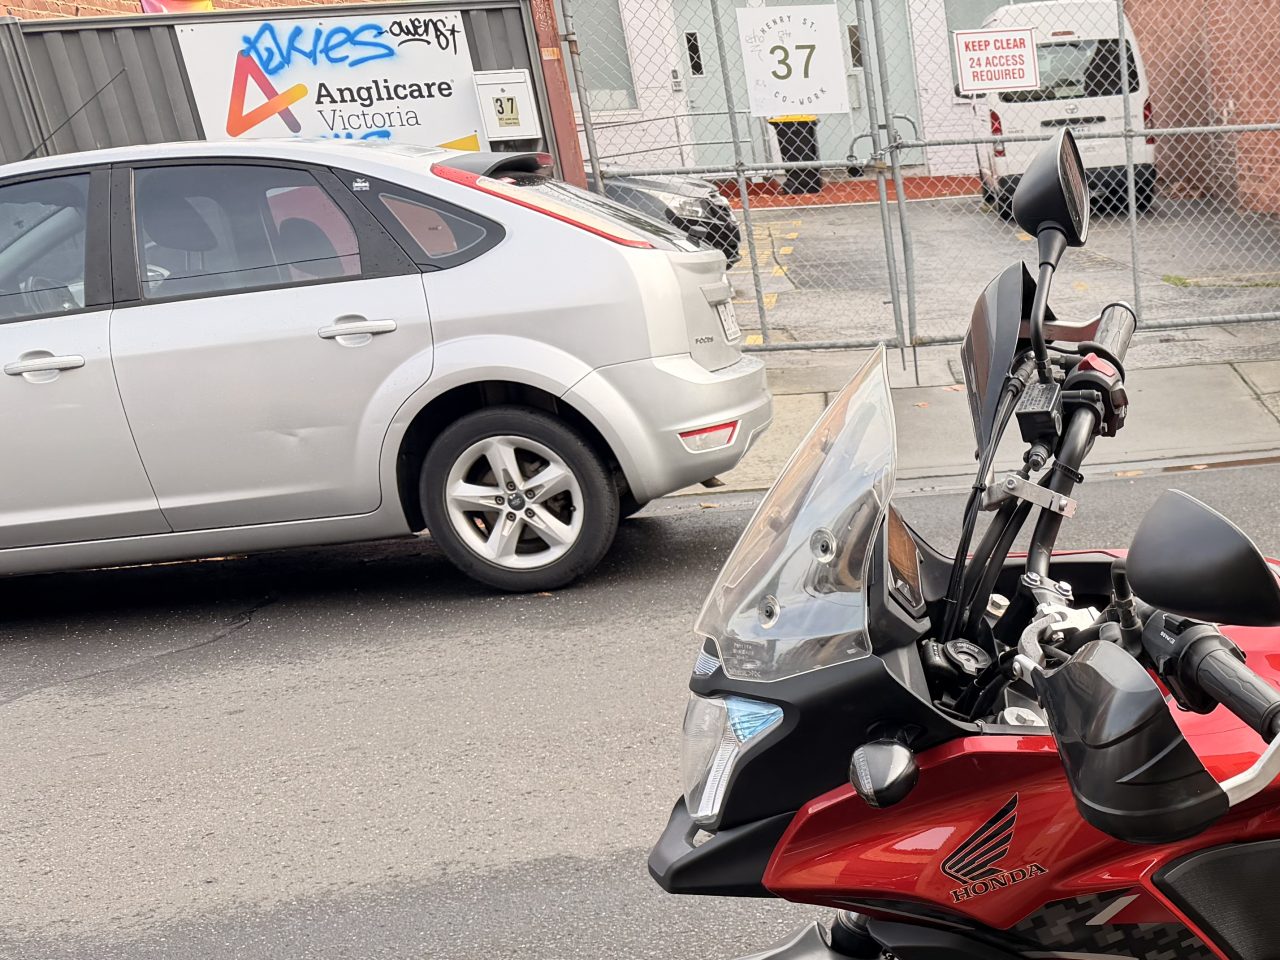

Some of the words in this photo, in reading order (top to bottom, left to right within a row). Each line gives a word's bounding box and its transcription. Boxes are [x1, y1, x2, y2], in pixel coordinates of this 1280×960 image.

[760, 15, 791, 35] HENRY
[802, 17, 817, 32] ST.
[964, 39, 991, 52] KEEP
[993, 37, 1027, 51] CLEAR
[769, 44, 816, 80] 37
[969, 57, 982, 69] 24
[984, 54, 1025, 68] ACCESS
[972, 68, 1025, 82] REQUIRED
[315, 78, 453, 108] Anglicare
[774, 87, 827, 105] CO-WORK
[495, 97, 514, 115] 37
[317, 106, 421, 131] Victoria
[950, 862, 1049, 903] HONDA
